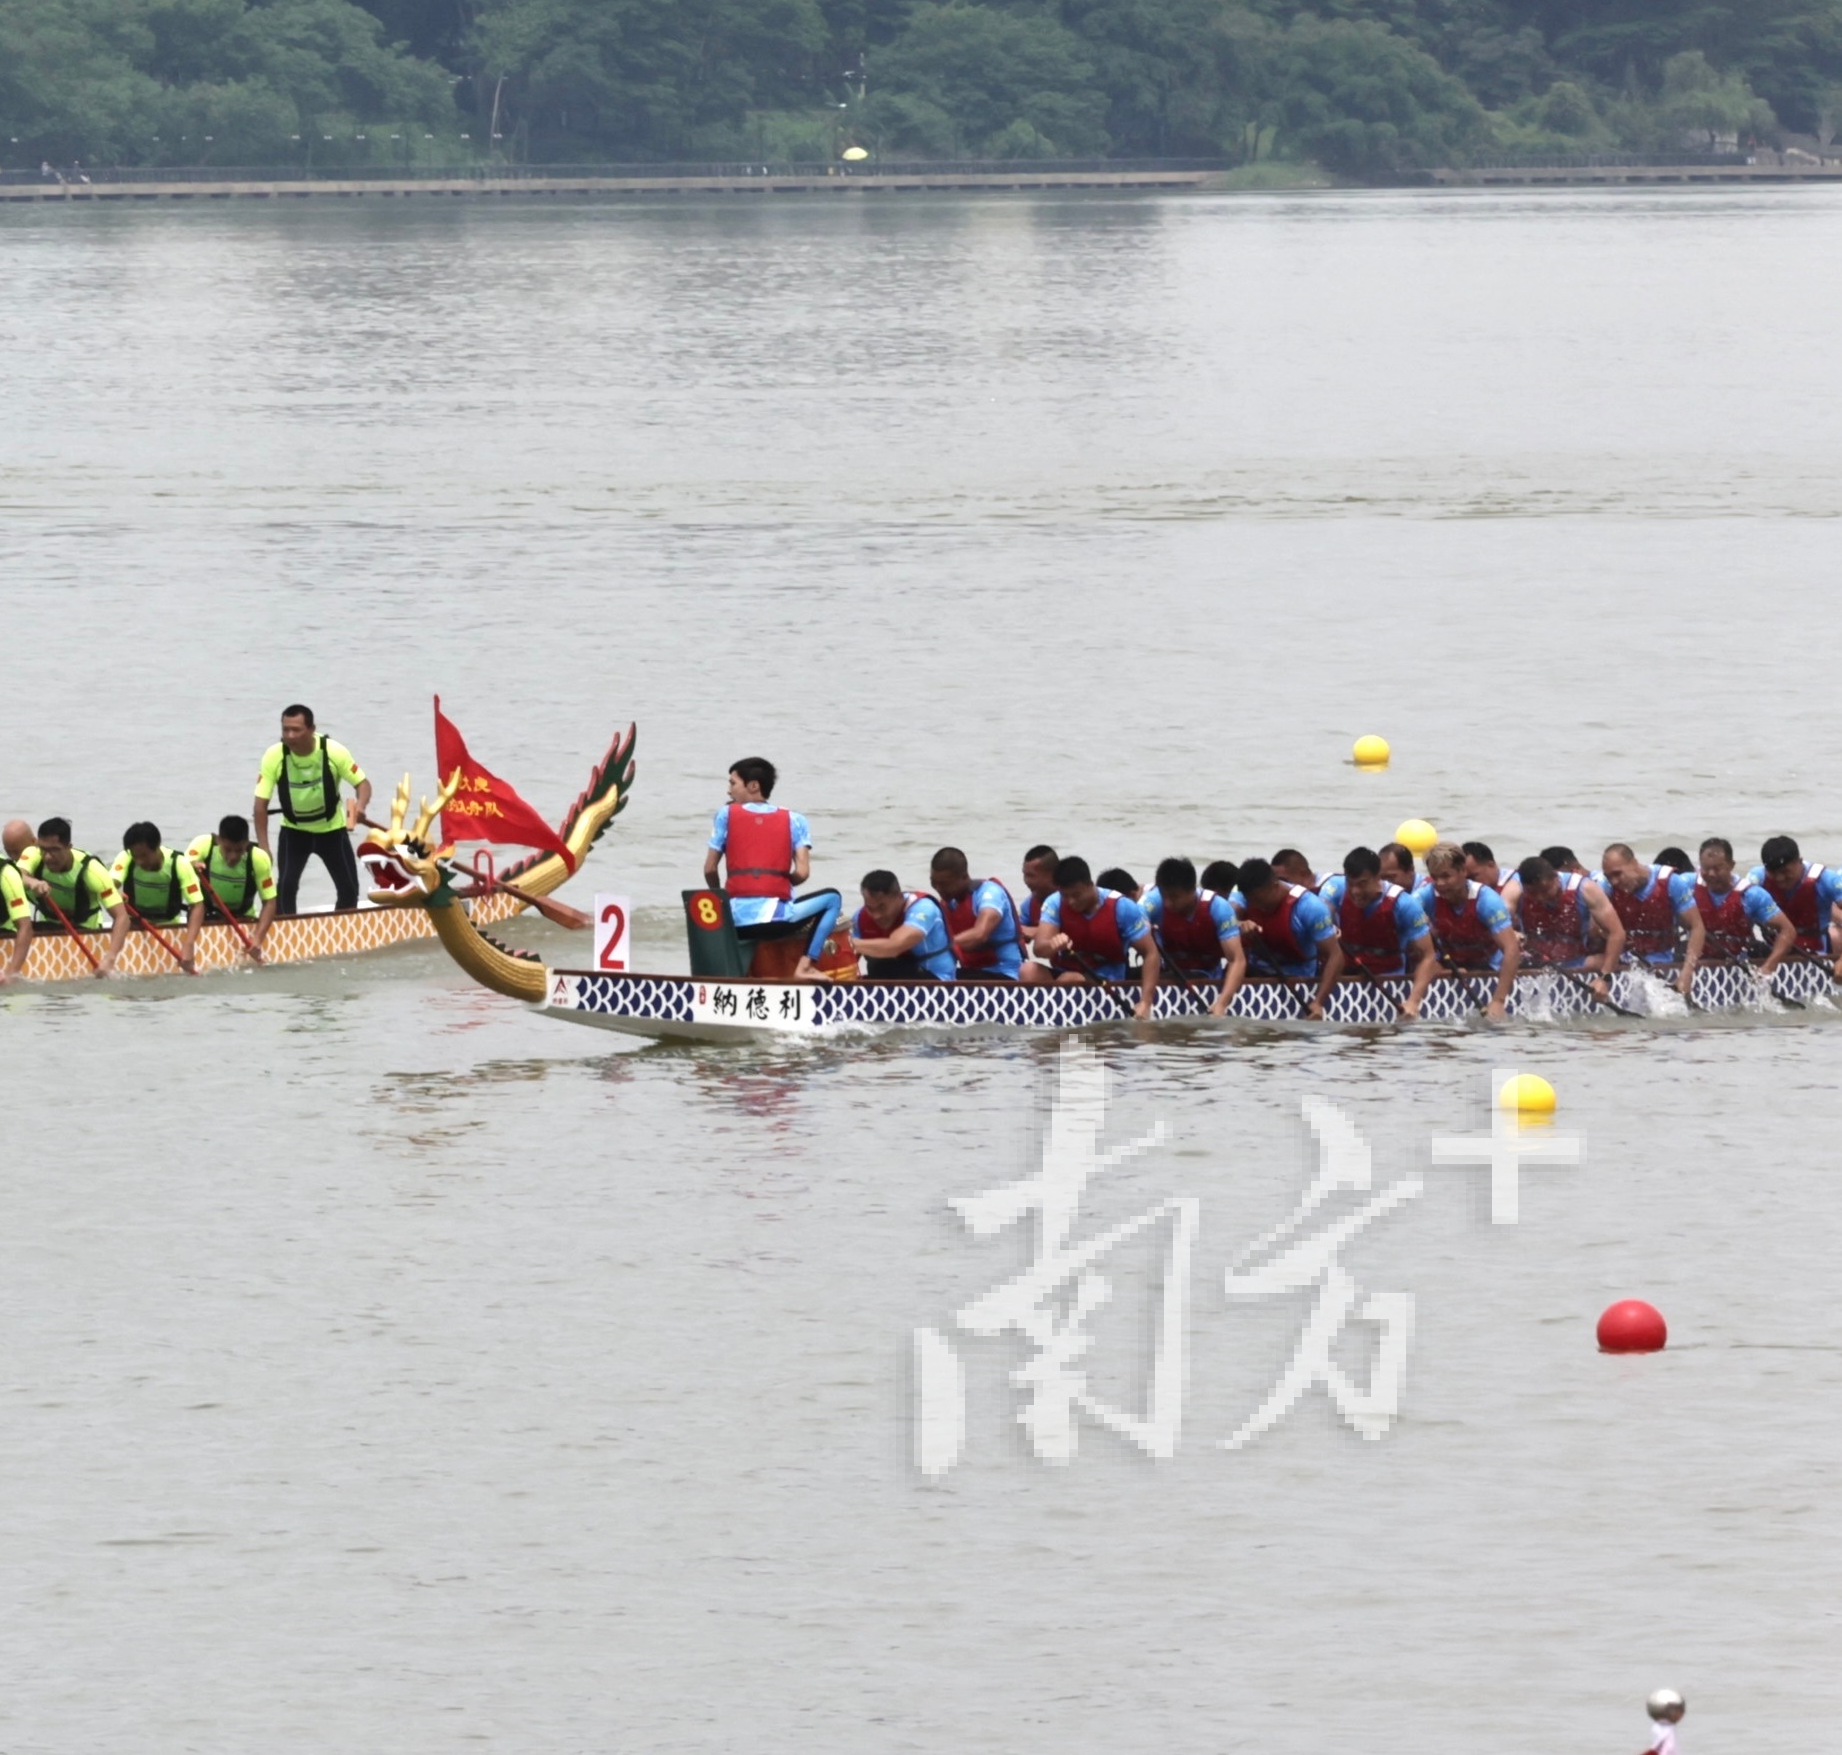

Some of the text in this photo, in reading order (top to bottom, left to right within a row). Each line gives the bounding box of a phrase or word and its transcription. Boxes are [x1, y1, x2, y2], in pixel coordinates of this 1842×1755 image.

[697, 898, 718, 924] 8
[599, 904, 625, 970] 2
[713, 986, 801, 1021] 納德利
